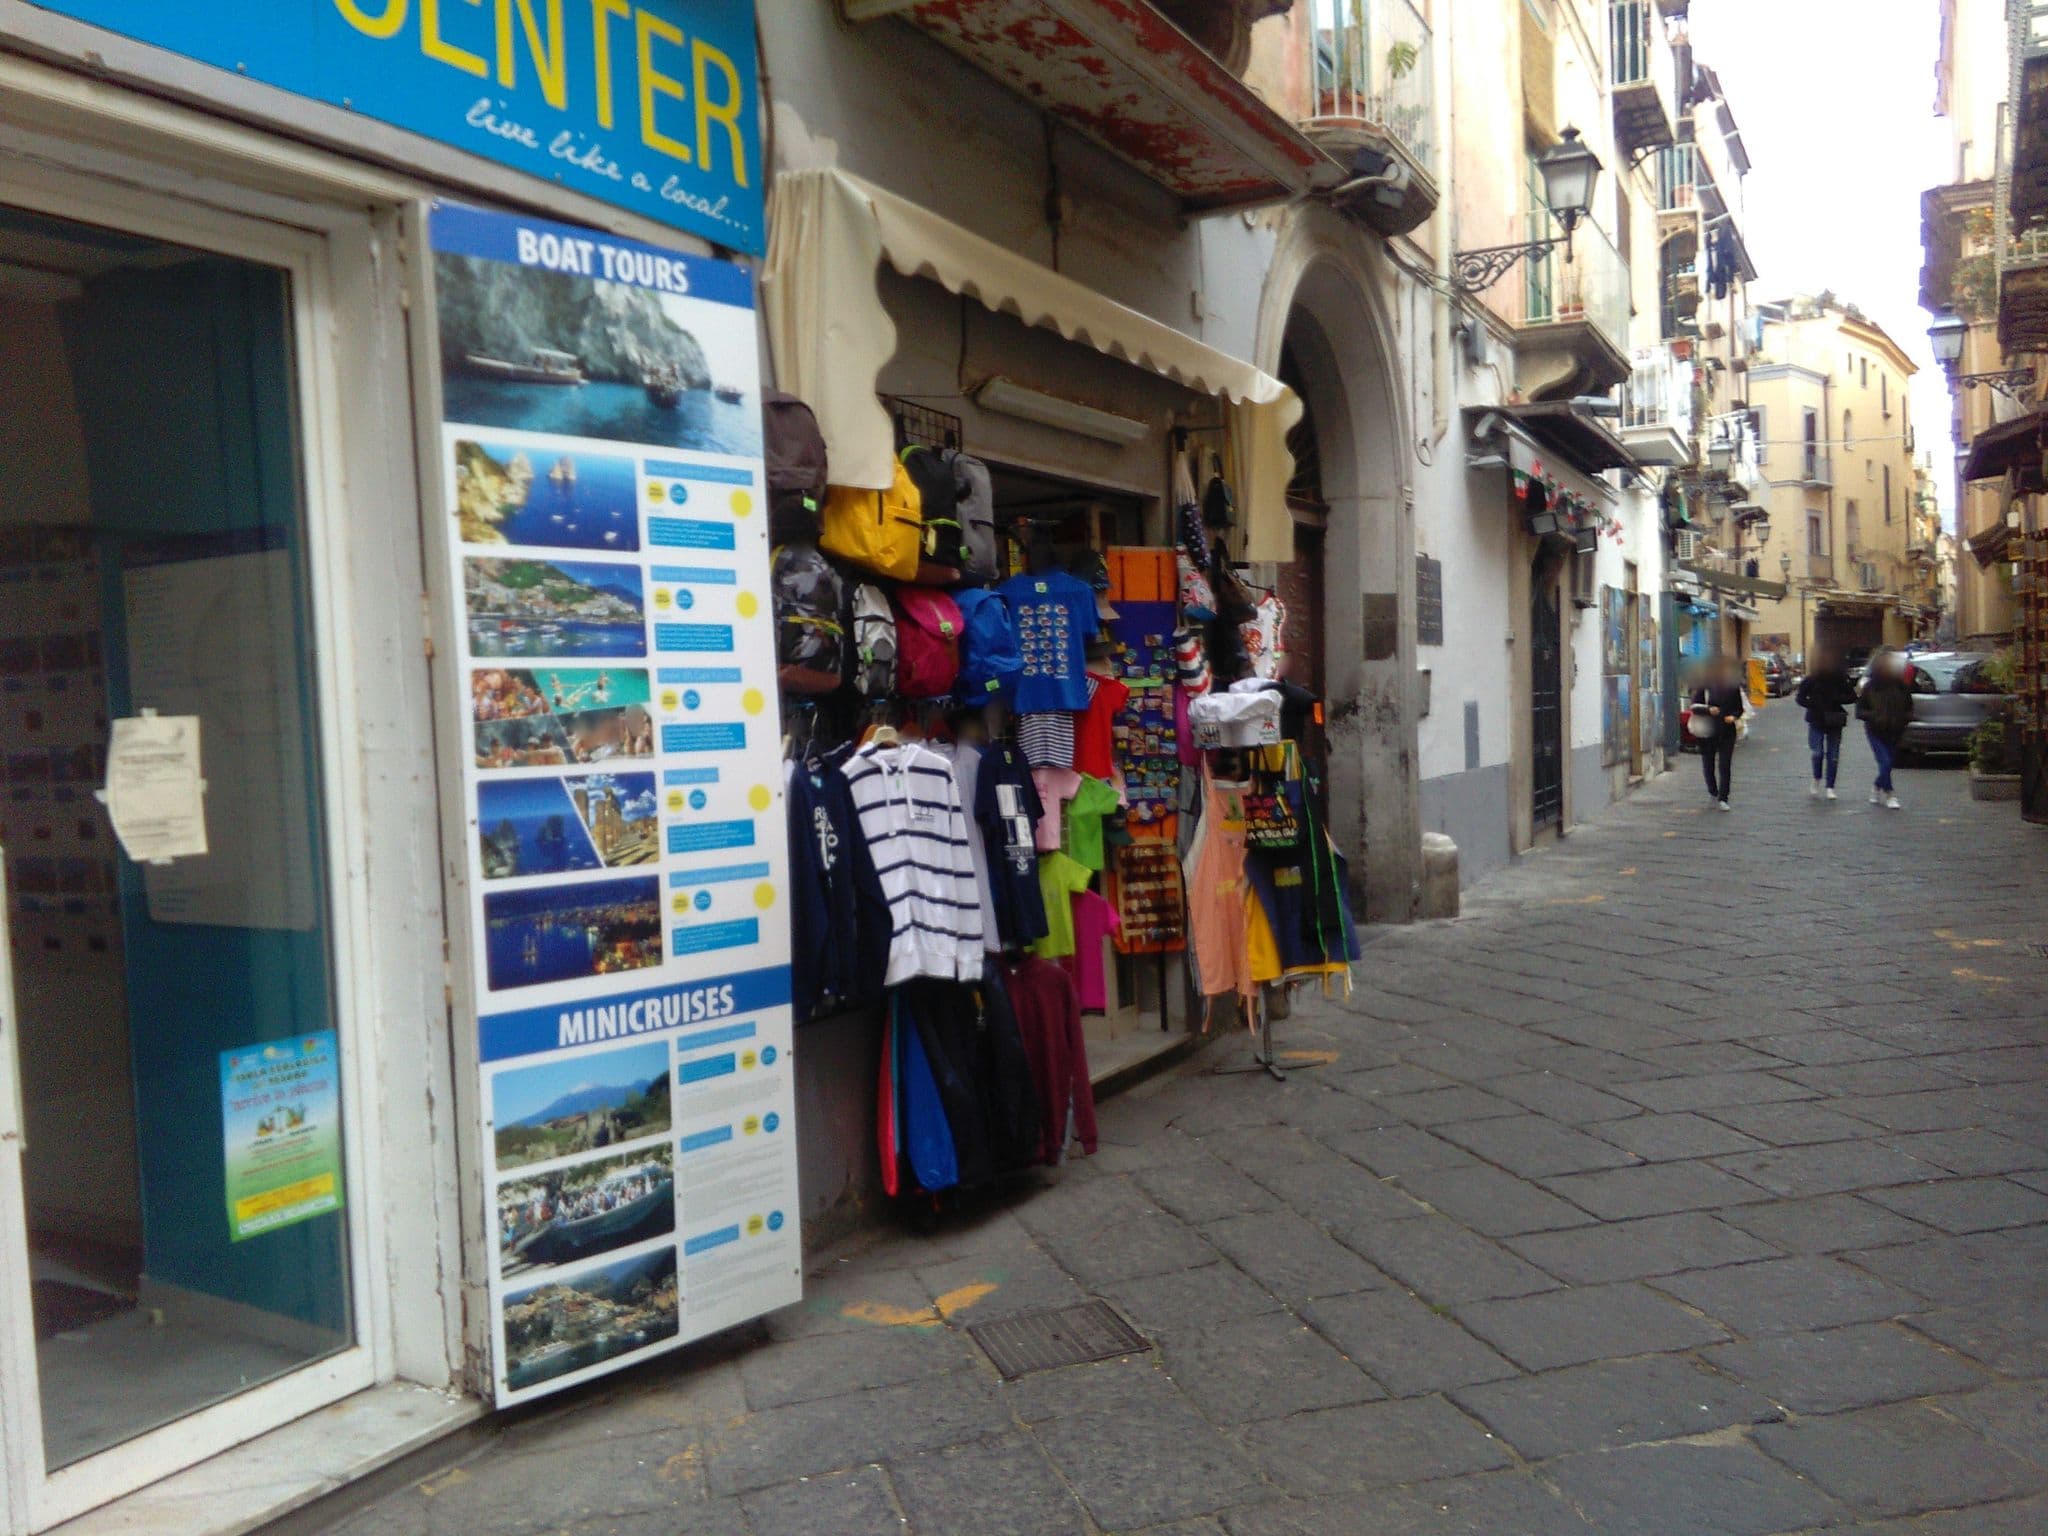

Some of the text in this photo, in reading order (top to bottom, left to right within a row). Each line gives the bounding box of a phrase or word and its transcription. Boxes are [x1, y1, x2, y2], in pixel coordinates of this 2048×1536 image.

[333, 0, 749, 188] ENTER
[466, 97, 539, 148] live
[549, 131, 622, 181] like
[631, 171, 652, 193] a
[517, 228, 690, 293] BOAT TOURS
[557, 984, 736, 1047] MINICRUISES
